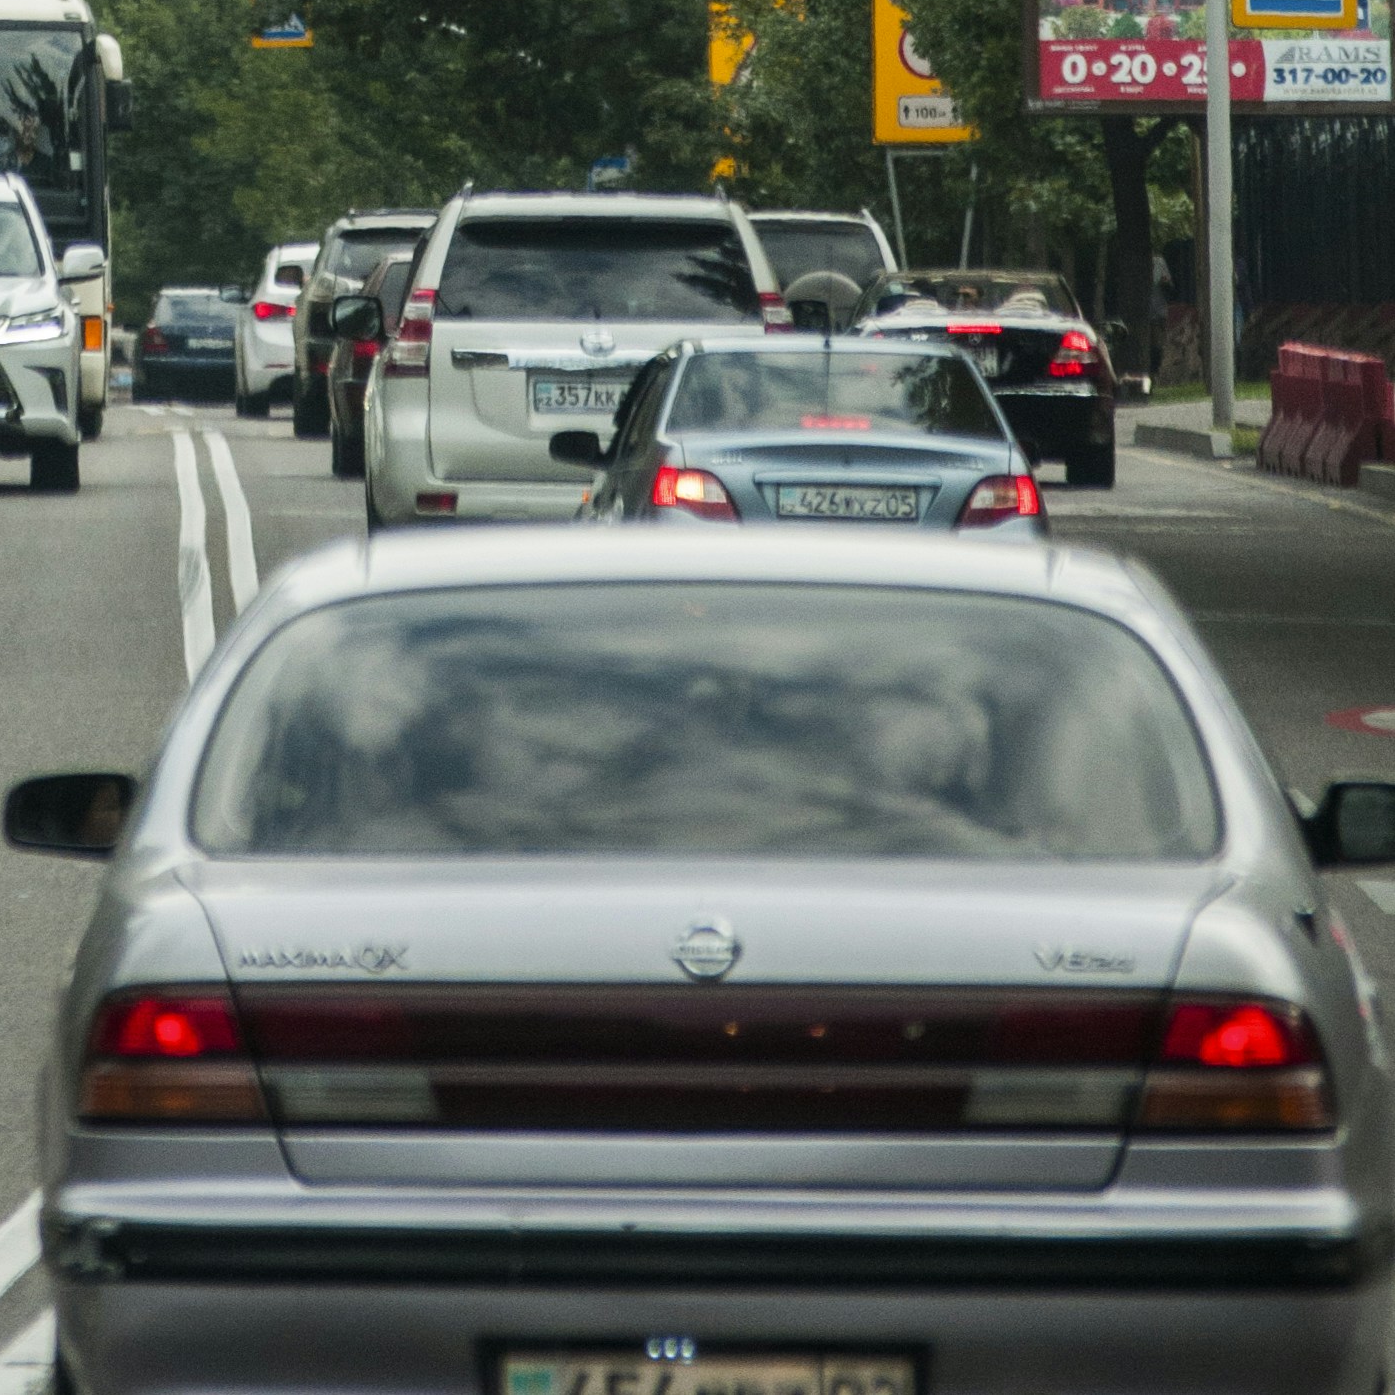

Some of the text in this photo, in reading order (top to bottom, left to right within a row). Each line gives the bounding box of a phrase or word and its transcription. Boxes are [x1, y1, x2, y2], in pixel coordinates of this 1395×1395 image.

[1296, 46, 1382, 64] RAMS
[1061, 53, 1208, 86] 0 20 2
[1272, 67, 1387, 85] 317-00-20
